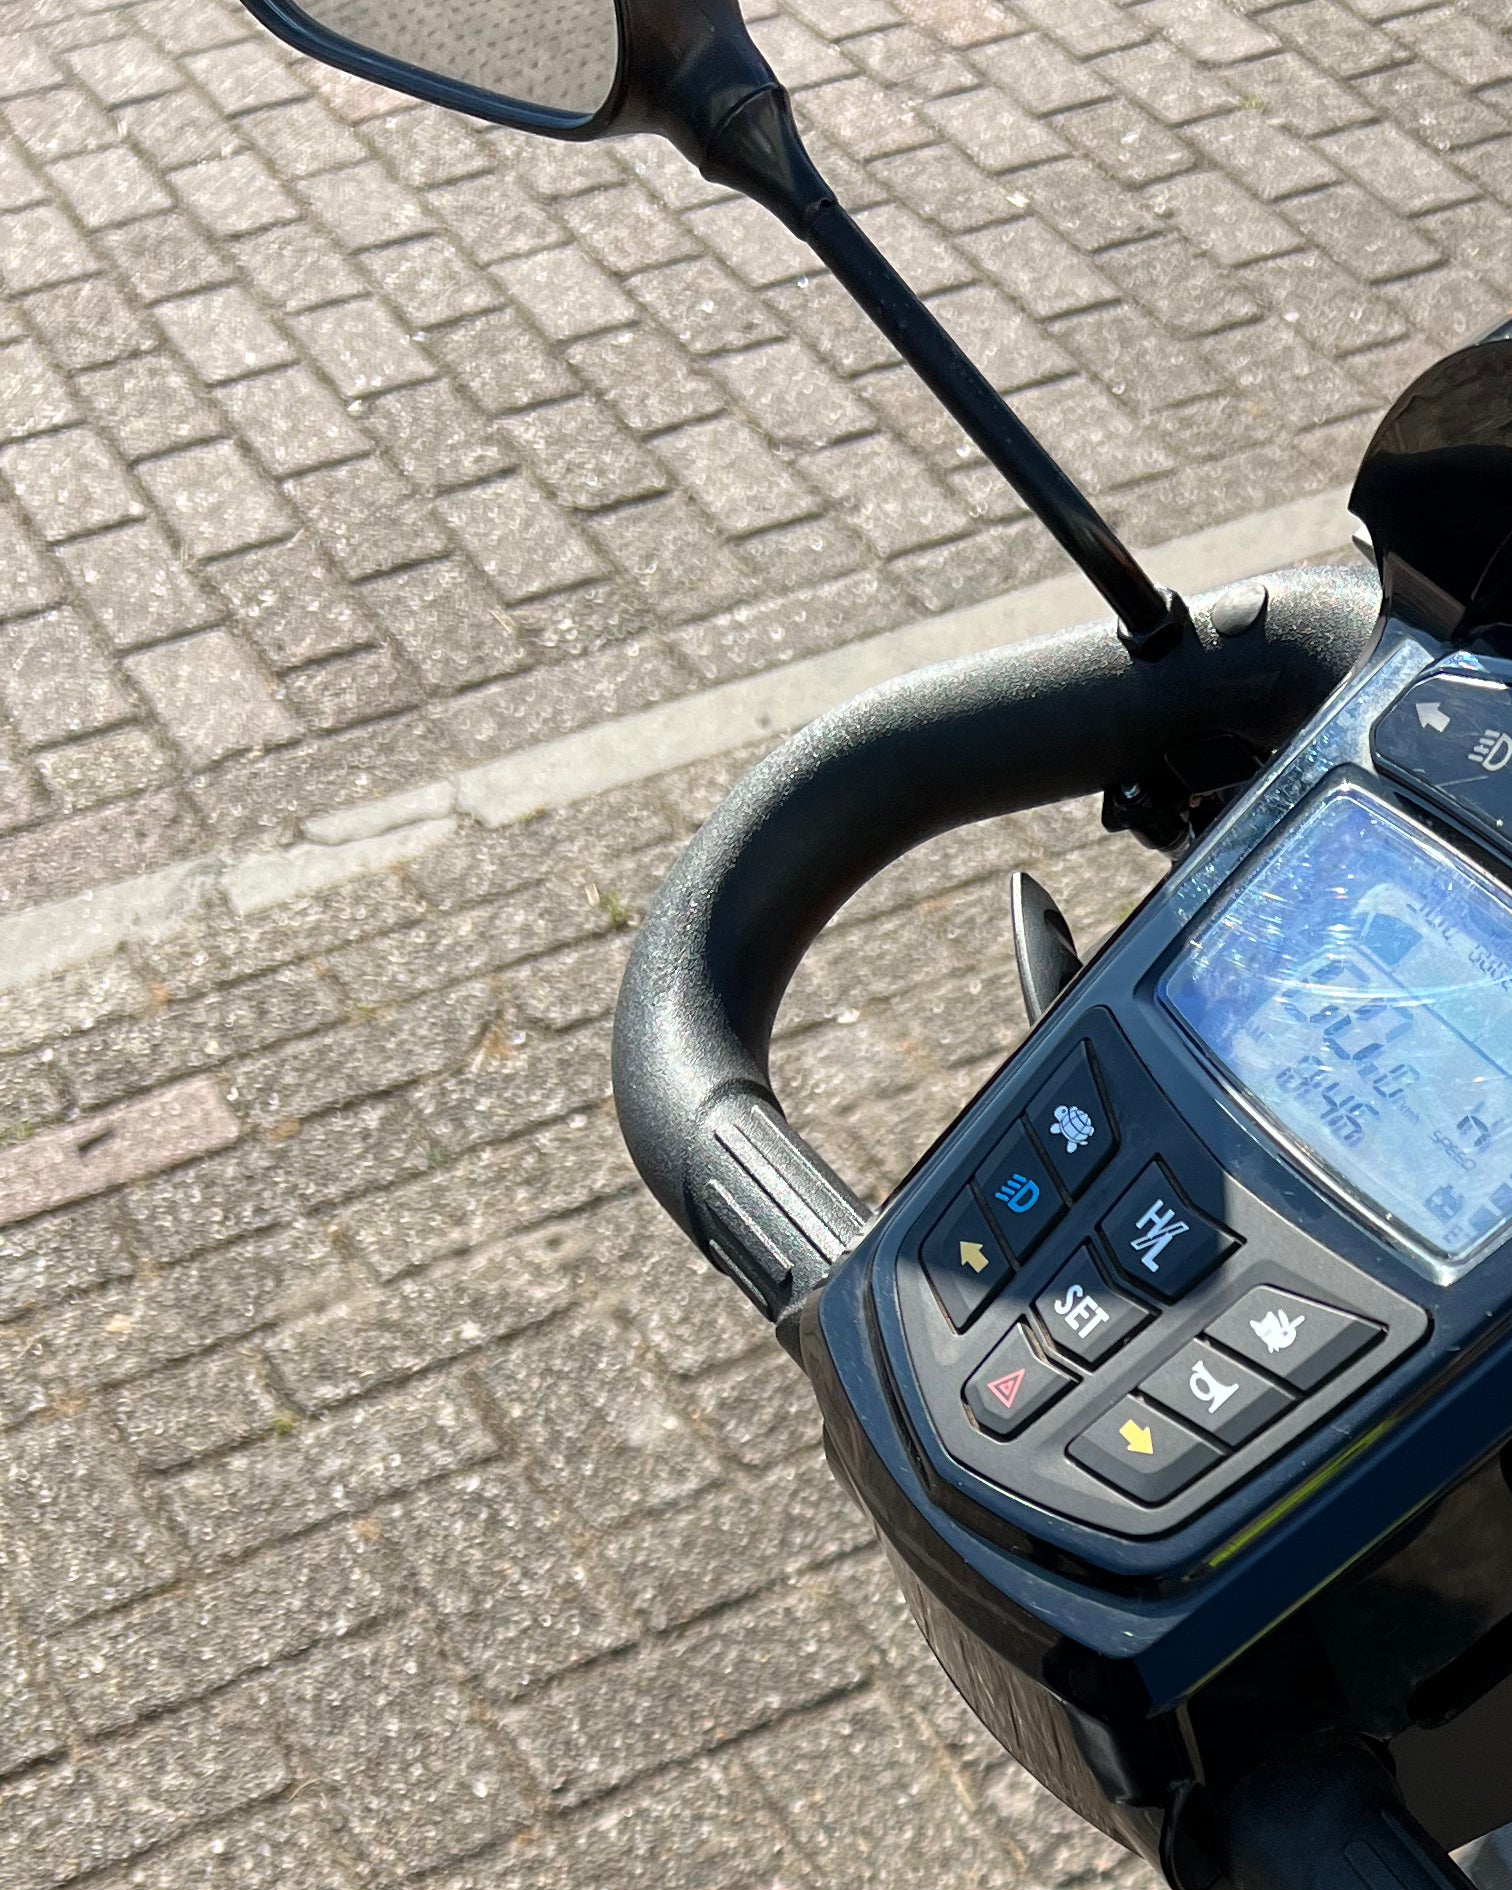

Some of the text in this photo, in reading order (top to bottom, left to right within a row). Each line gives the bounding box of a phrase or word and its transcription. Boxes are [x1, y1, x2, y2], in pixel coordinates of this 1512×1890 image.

[1428, 1129, 1478, 1172] SPEED
[1130, 1199, 1190, 1273] H/L
[1054, 1285, 1110, 1339] SET
